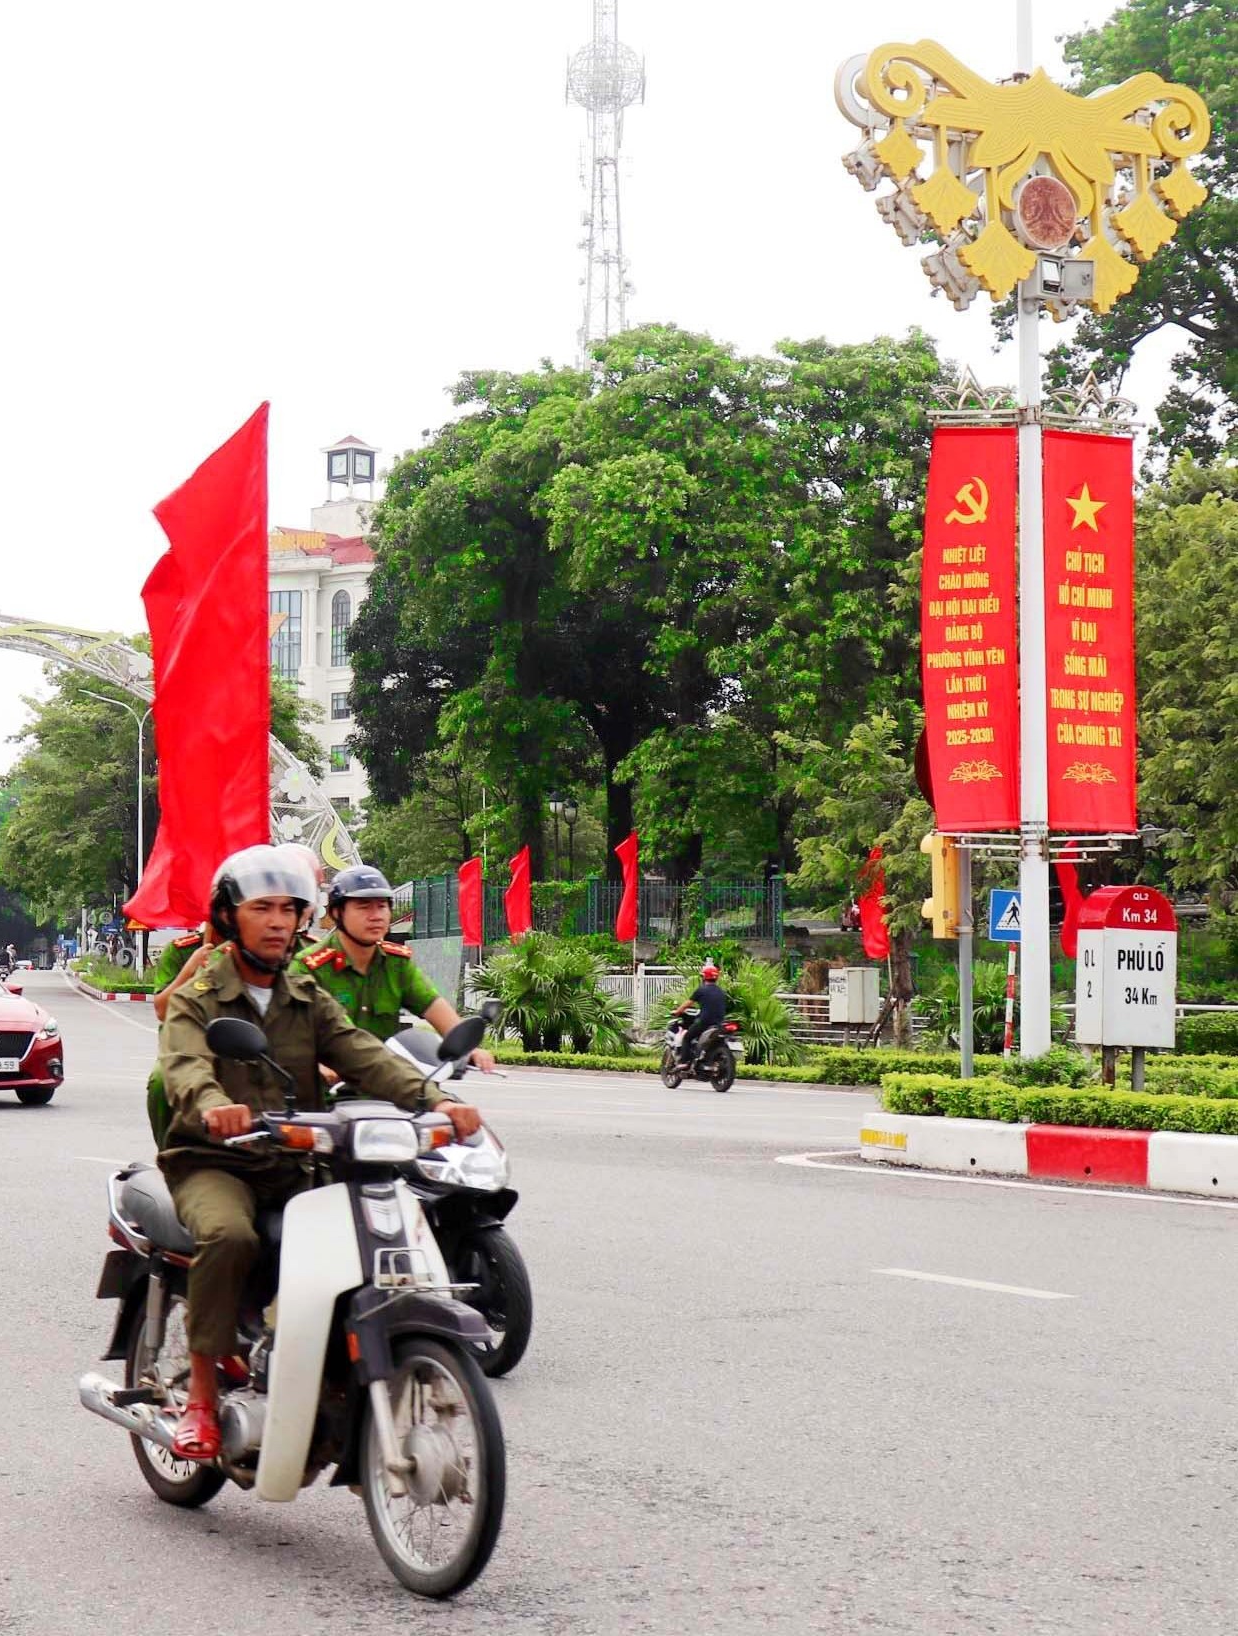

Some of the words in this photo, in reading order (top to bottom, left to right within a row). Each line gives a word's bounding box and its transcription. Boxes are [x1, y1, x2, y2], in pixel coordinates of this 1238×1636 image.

[943, 545, 966, 567] NHIỆT
[969, 544, 987, 566] LIỆT
[1065, 546, 1083, 573] CHỦ
[1084, 552, 1105, 577] TỊCH
[939, 571, 961, 590] CHÀO
[963, 570, 989, 589] MỪNG
[1058, 579, 1070, 605] HỒ
[1071, 583, 1086, 607] CHÍ
[1086, 587, 1113, 609] MINH
[929, 601, 944, 620] ĐẠI
[945, 597, 961, 619] HỘI
[962, 599, 978, 618] ĐẠI
[979, 593, 1000, 614] BIỂU
[945, 621, 970, 642] ĐẢNG
[971, 622, 983, 643] BỘ
[1071, 617, 1080, 641] VĨ
[1081, 622, 1097, 647] ĐẠI
[927, 650, 962, 668] PHƯỜNG
[963, 649, 985, 666] VĨNH
[986, 647, 1005, 665] YÊN
[1064, 649, 1087, 676] SỐNG
[1088, 653, 1107, 677] MÃI
[946, 674, 963, 694] LẦN
[964, 673, 982, 692] THỨ
[982, 676, 987, 692] I
[947, 701, 976, 721] NHIỆM
[977, 699, 988, 718] KỲ
[1050, 688, 1076, 710] TRONG
[1077, 689, 1090, 715] SỰ
[1090, 688, 1124, 717] NGHIỆP
[946, 727, 994, 745] 2025-2030!
[1057, 716, 1075, 744] CỦA
[1076, 721, 1106, 746] CHÚNG
[1108, 726, 1122, 747] TA!
[1133, 892, 1150, 901] QL2
[1122, 907, 1141, 923] Km
[1144, 909, 1158, 923] 34
[1117, 942, 1145, 971] PHỦ
[1148, 942, 1165, 971] LỖ
[1087, 980, 1093, 999] 2
[1125, 987, 1139, 1005] 34
[1142, 987, 1158, 1005] Km
